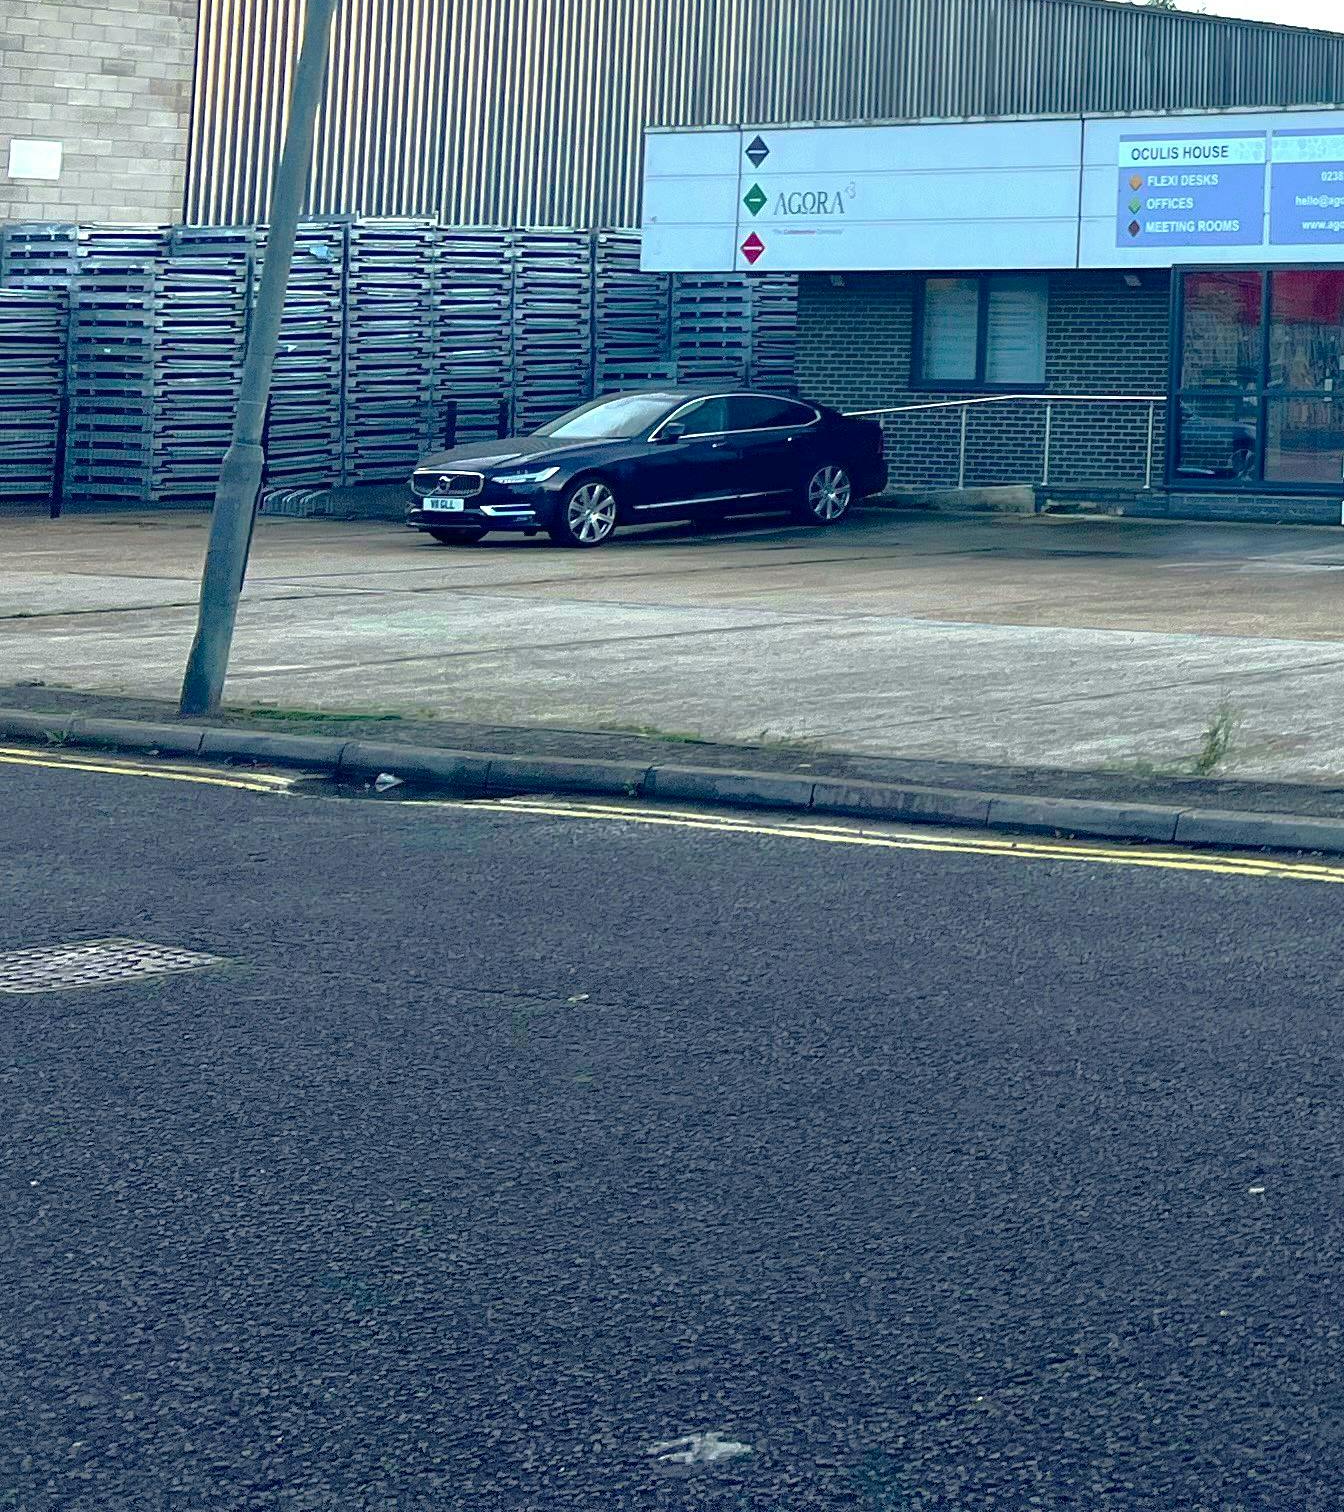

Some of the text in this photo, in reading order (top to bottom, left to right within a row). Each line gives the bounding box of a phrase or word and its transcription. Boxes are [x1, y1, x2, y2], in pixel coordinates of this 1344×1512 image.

[1131, 145, 1229, 161] OCULIS HOUSE
[1147, 173, 1219, 187] FLEXI DESKS
[1146, 197, 1194, 210] OFFICES
[1145, 219, 1240, 233] MEETING ROOMS
